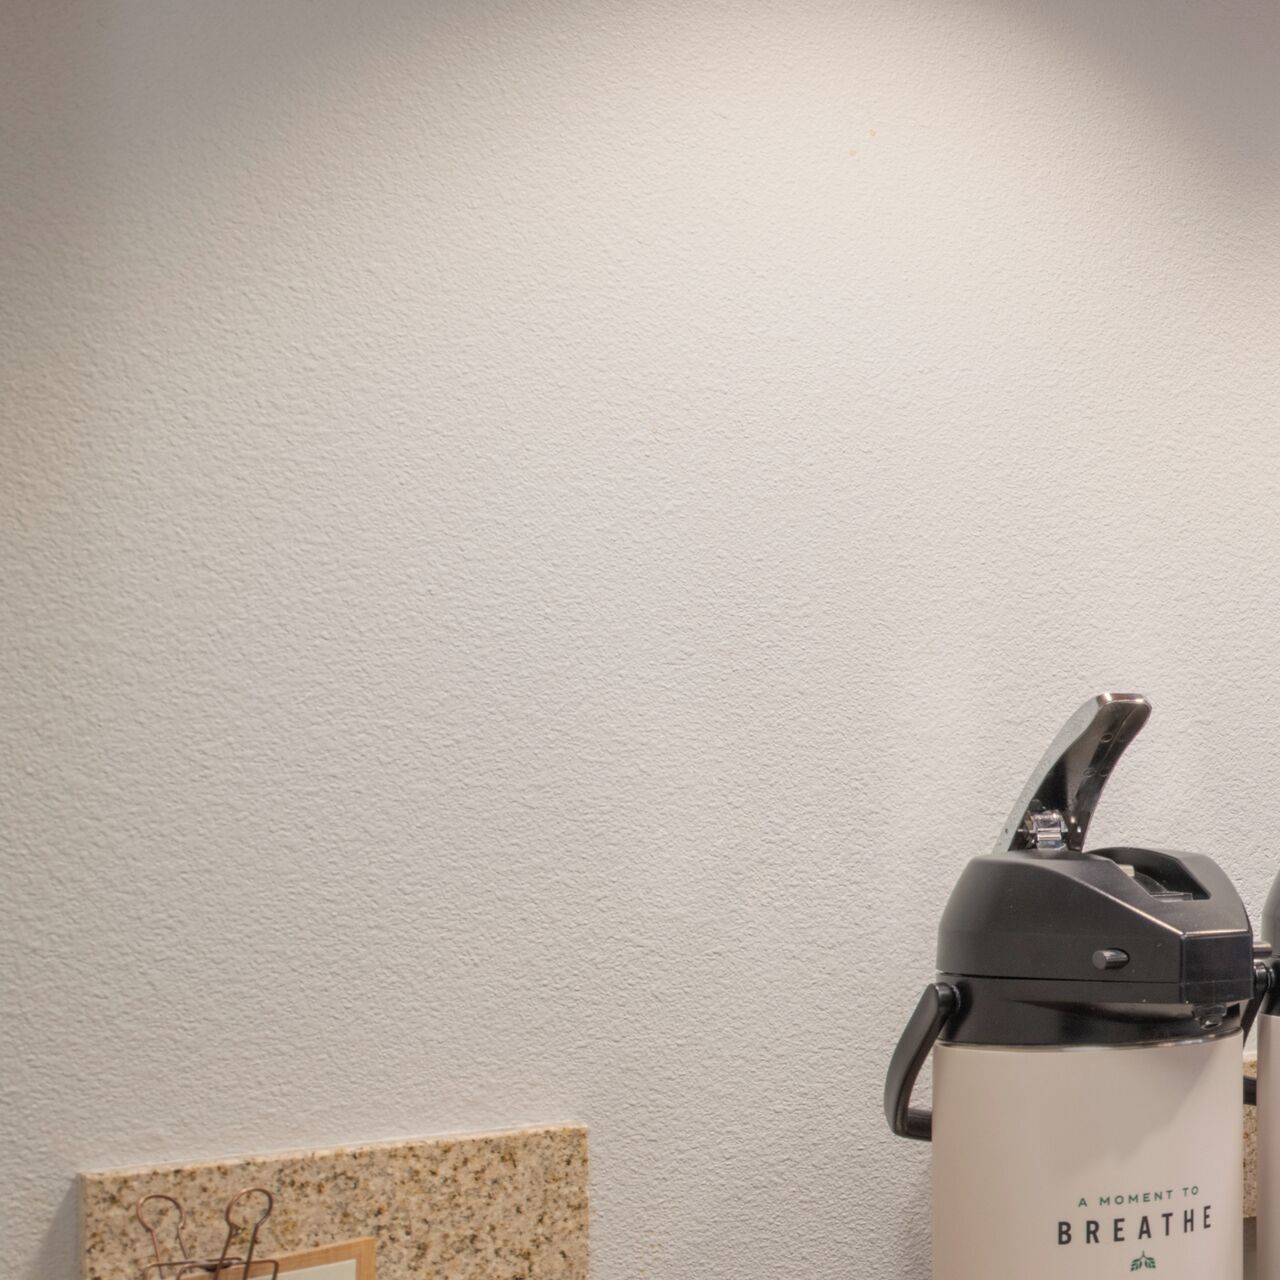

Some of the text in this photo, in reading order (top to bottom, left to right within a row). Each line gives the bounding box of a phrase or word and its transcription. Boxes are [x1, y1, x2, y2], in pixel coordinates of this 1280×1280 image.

[1078, 1186, 1200, 1208] A MOMENT TO
[1057, 1205, 1212, 1245] BREATHE
